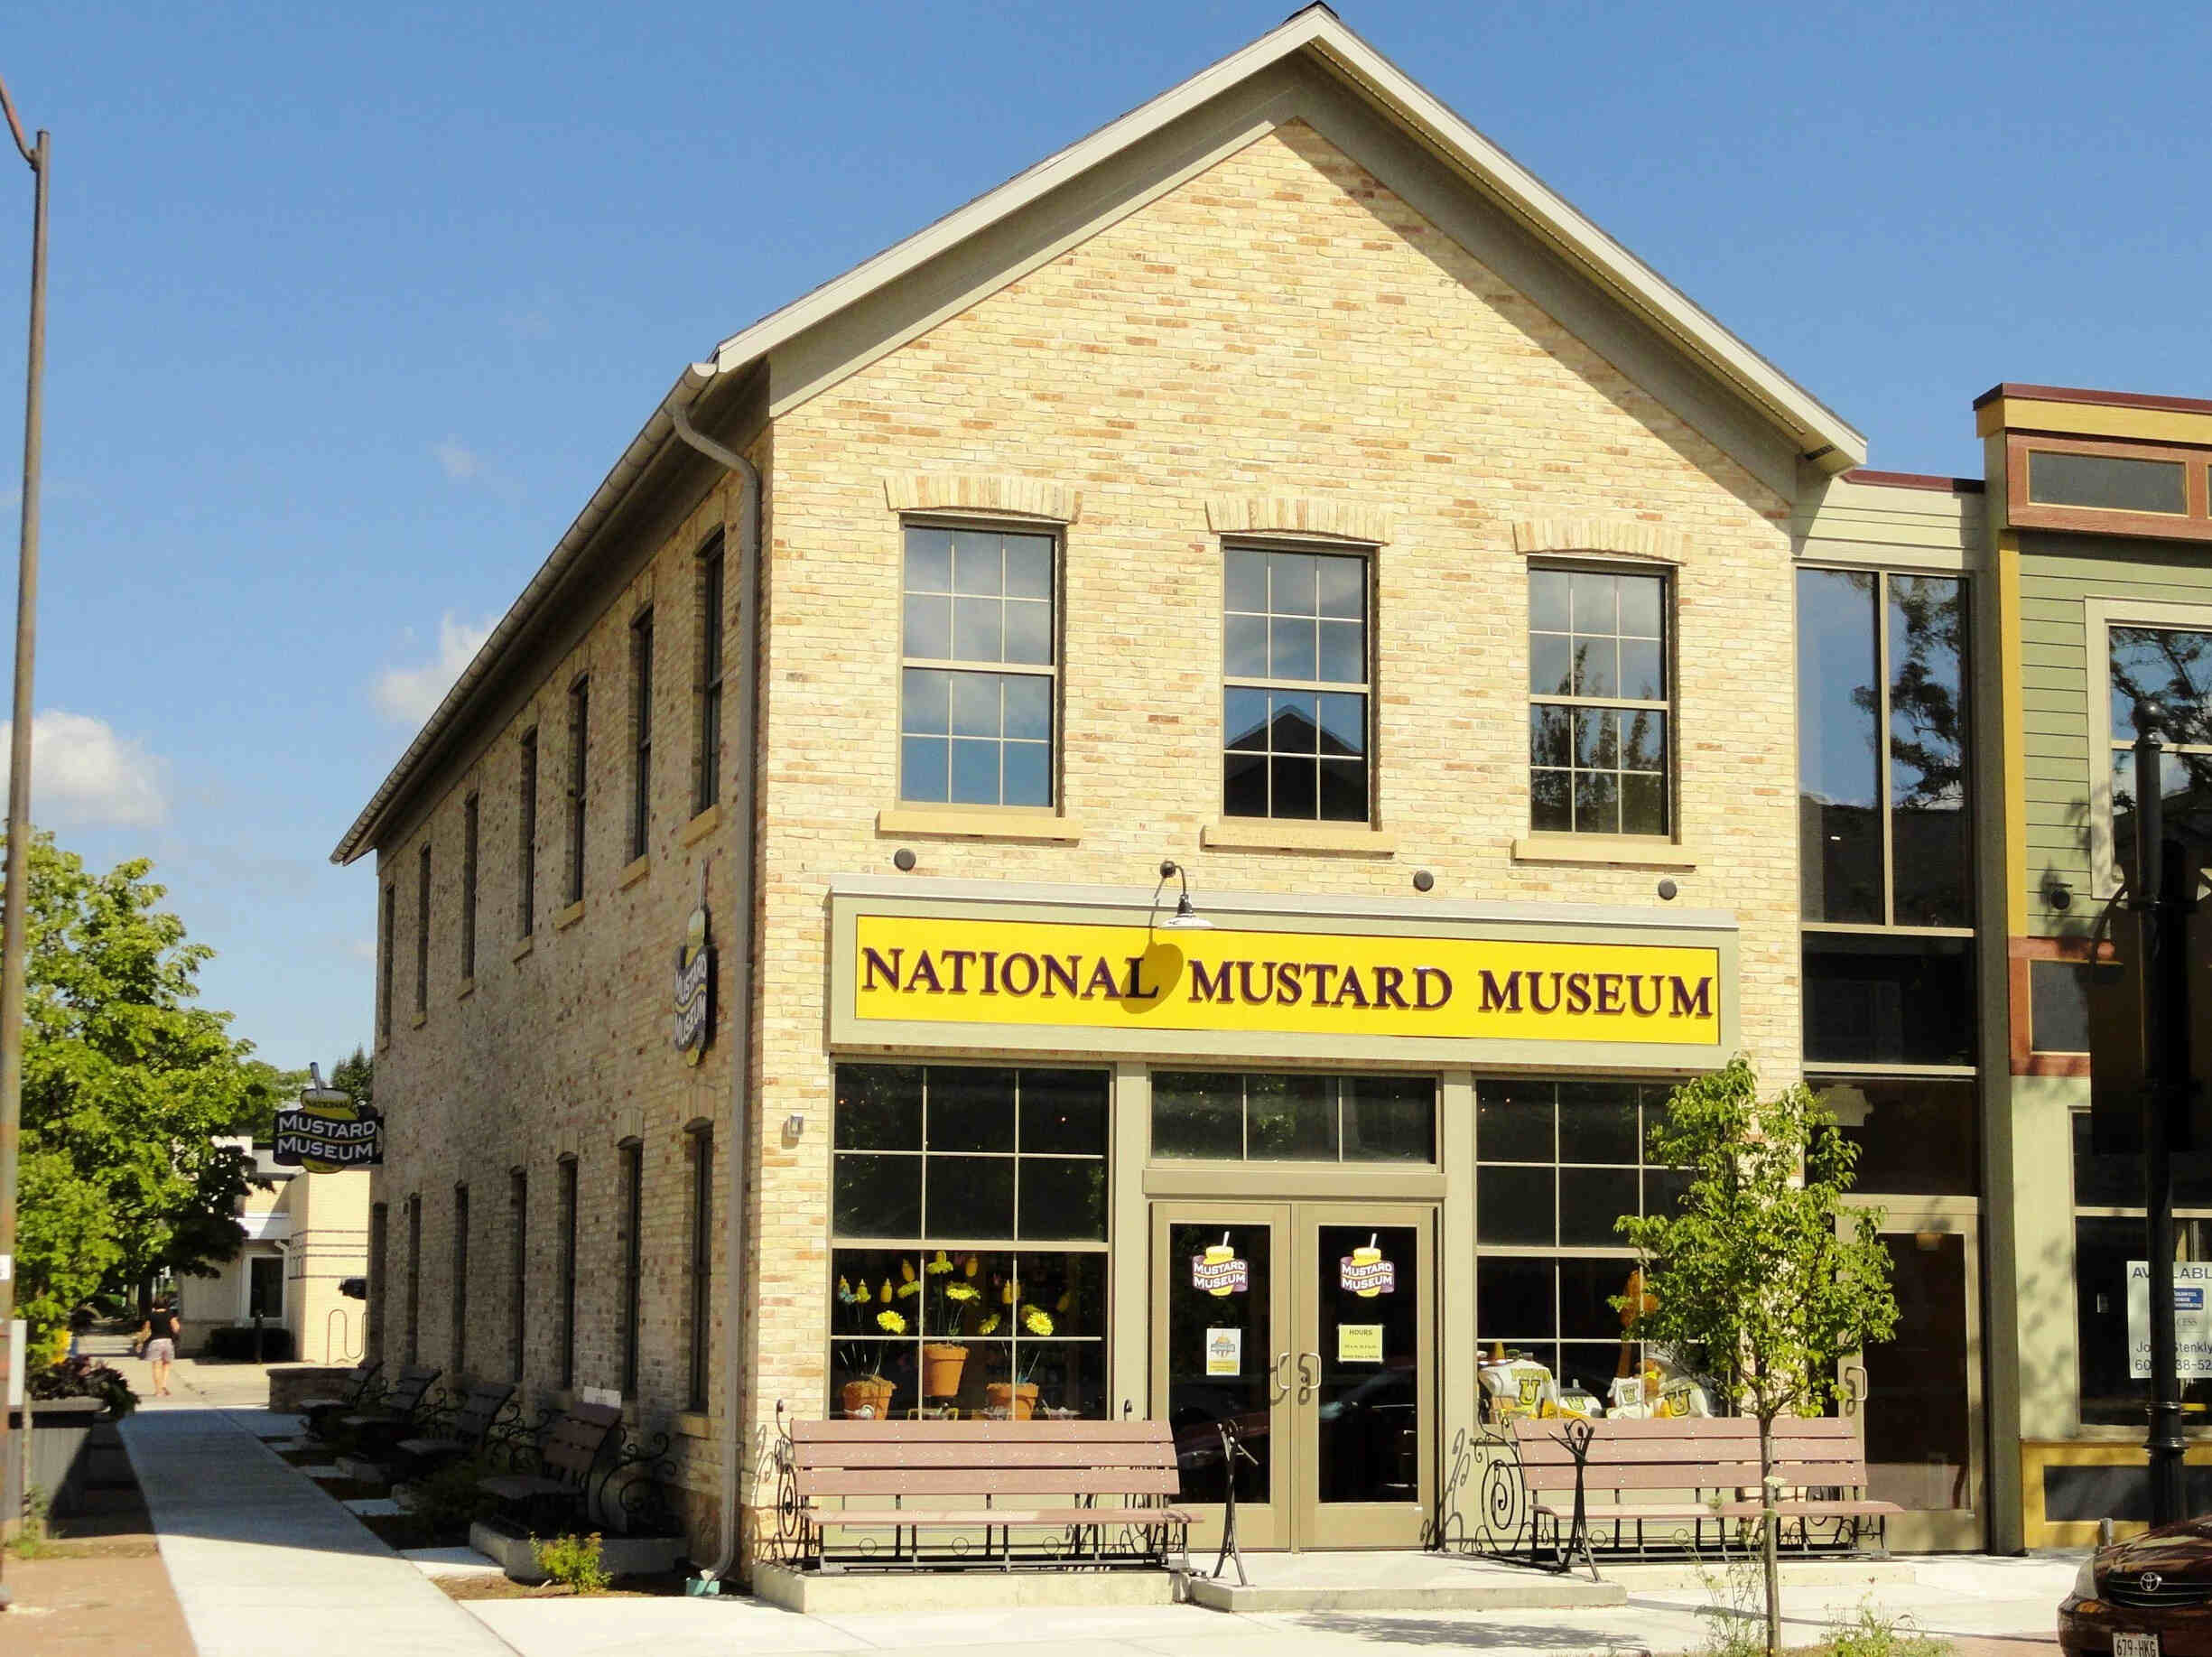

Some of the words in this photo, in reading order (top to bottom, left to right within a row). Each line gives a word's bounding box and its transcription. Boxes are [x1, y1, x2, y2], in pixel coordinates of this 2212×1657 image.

[674, 953, 708, 1005] MUSTARD
[860, 946, 1160, 1001] NATIONAL
[1187, 958, 1454, 1012] MUSTARD
[1477, 969, 1713, 1019] MUSEUM
[278, 1114, 376, 1139] MUSTARD
[276, 1136, 373, 1160] MUSEUM
[1194, 1261, 1246, 1275] MUSTARD
[1342, 1262, 1393, 1276] MUSTARD
[1194, 1274, 1246, 1289] MUSEUM
[1342, 1276, 1393, 1289] MUSEUM
[2116, 1639, 2157, 1657] 679-HKG
